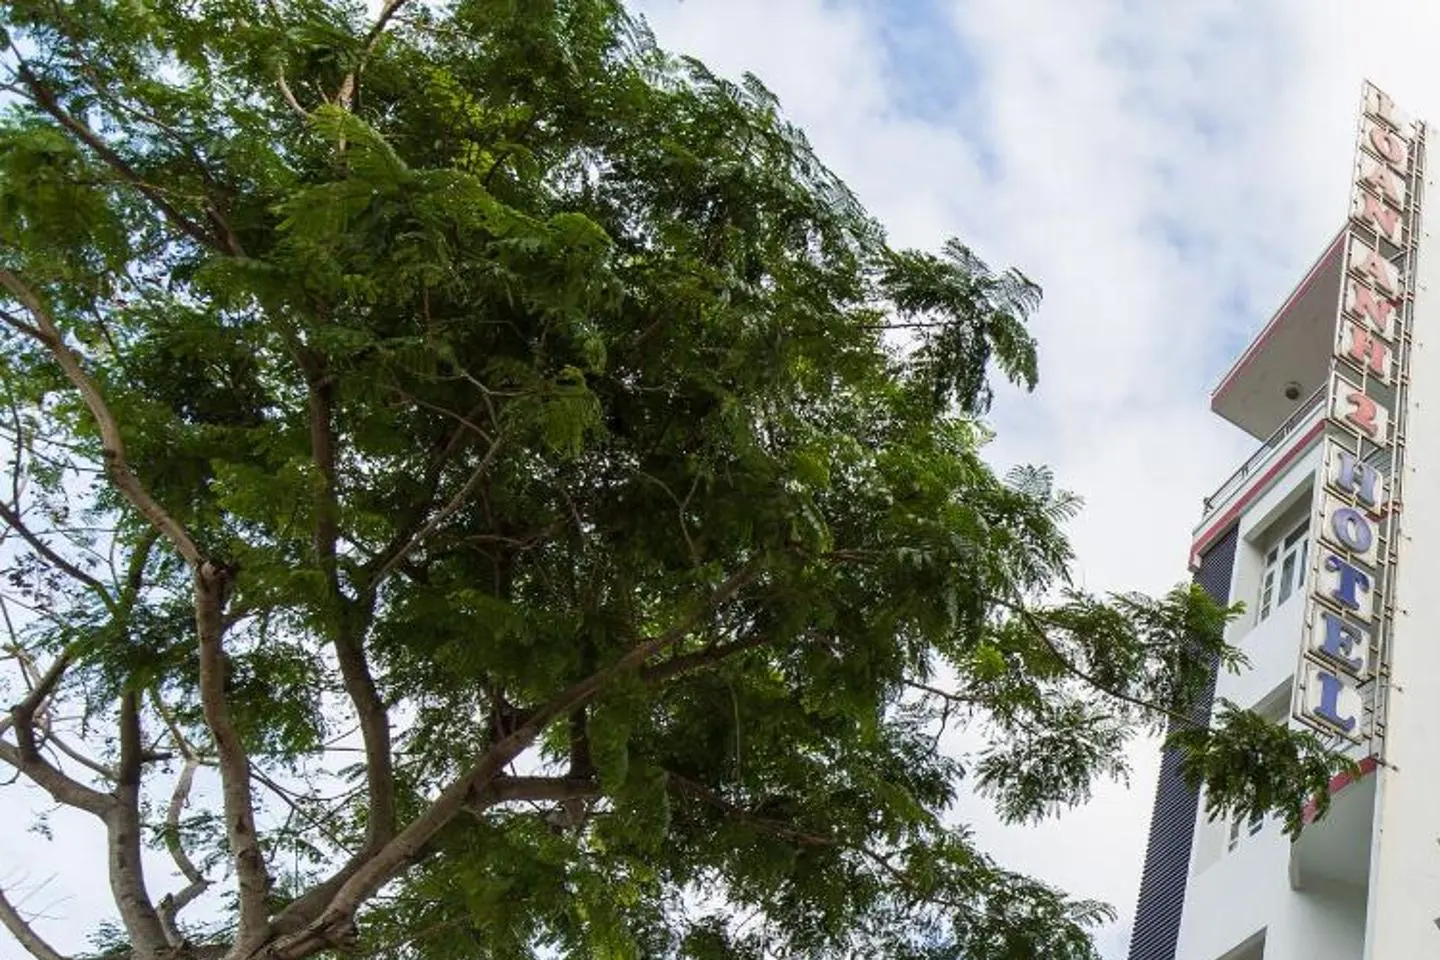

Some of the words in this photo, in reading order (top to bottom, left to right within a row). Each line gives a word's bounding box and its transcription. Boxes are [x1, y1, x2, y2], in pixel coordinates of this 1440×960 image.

[1346, 250, 1399, 379] ANH
[1345, 393, 1378, 438] 2
[1312, 450, 1378, 734] HOTEL
